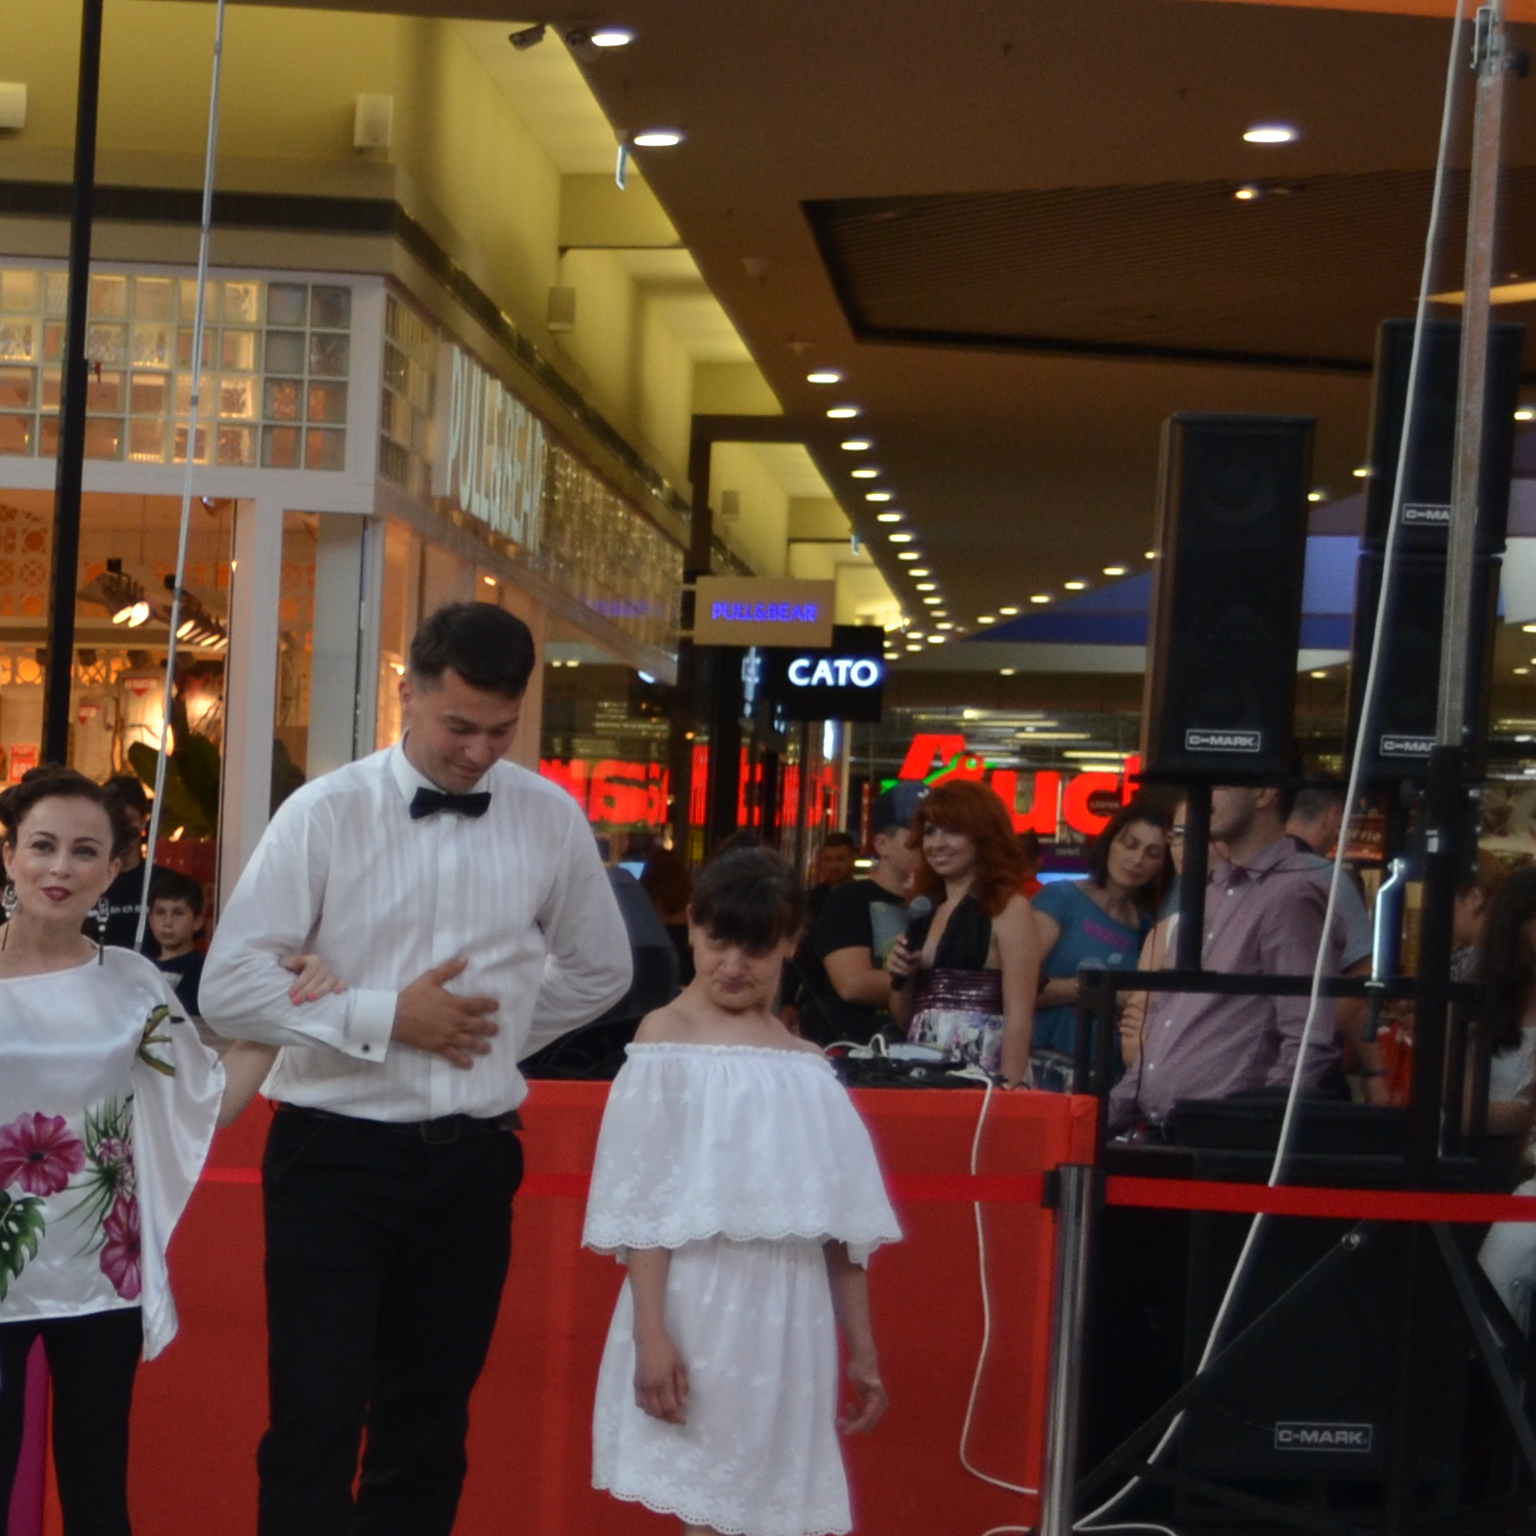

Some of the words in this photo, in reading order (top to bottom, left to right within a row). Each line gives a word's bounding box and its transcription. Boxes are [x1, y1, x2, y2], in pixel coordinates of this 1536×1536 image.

[1405, 509, 1451, 521] C-MA
[712, 602, 817, 623] PULL&BEAR
[787, 657, 880, 688] CATO
[1189, 735, 1254, 747] C-MARK
[1278, 1429, 1364, 1444] C-MARK
